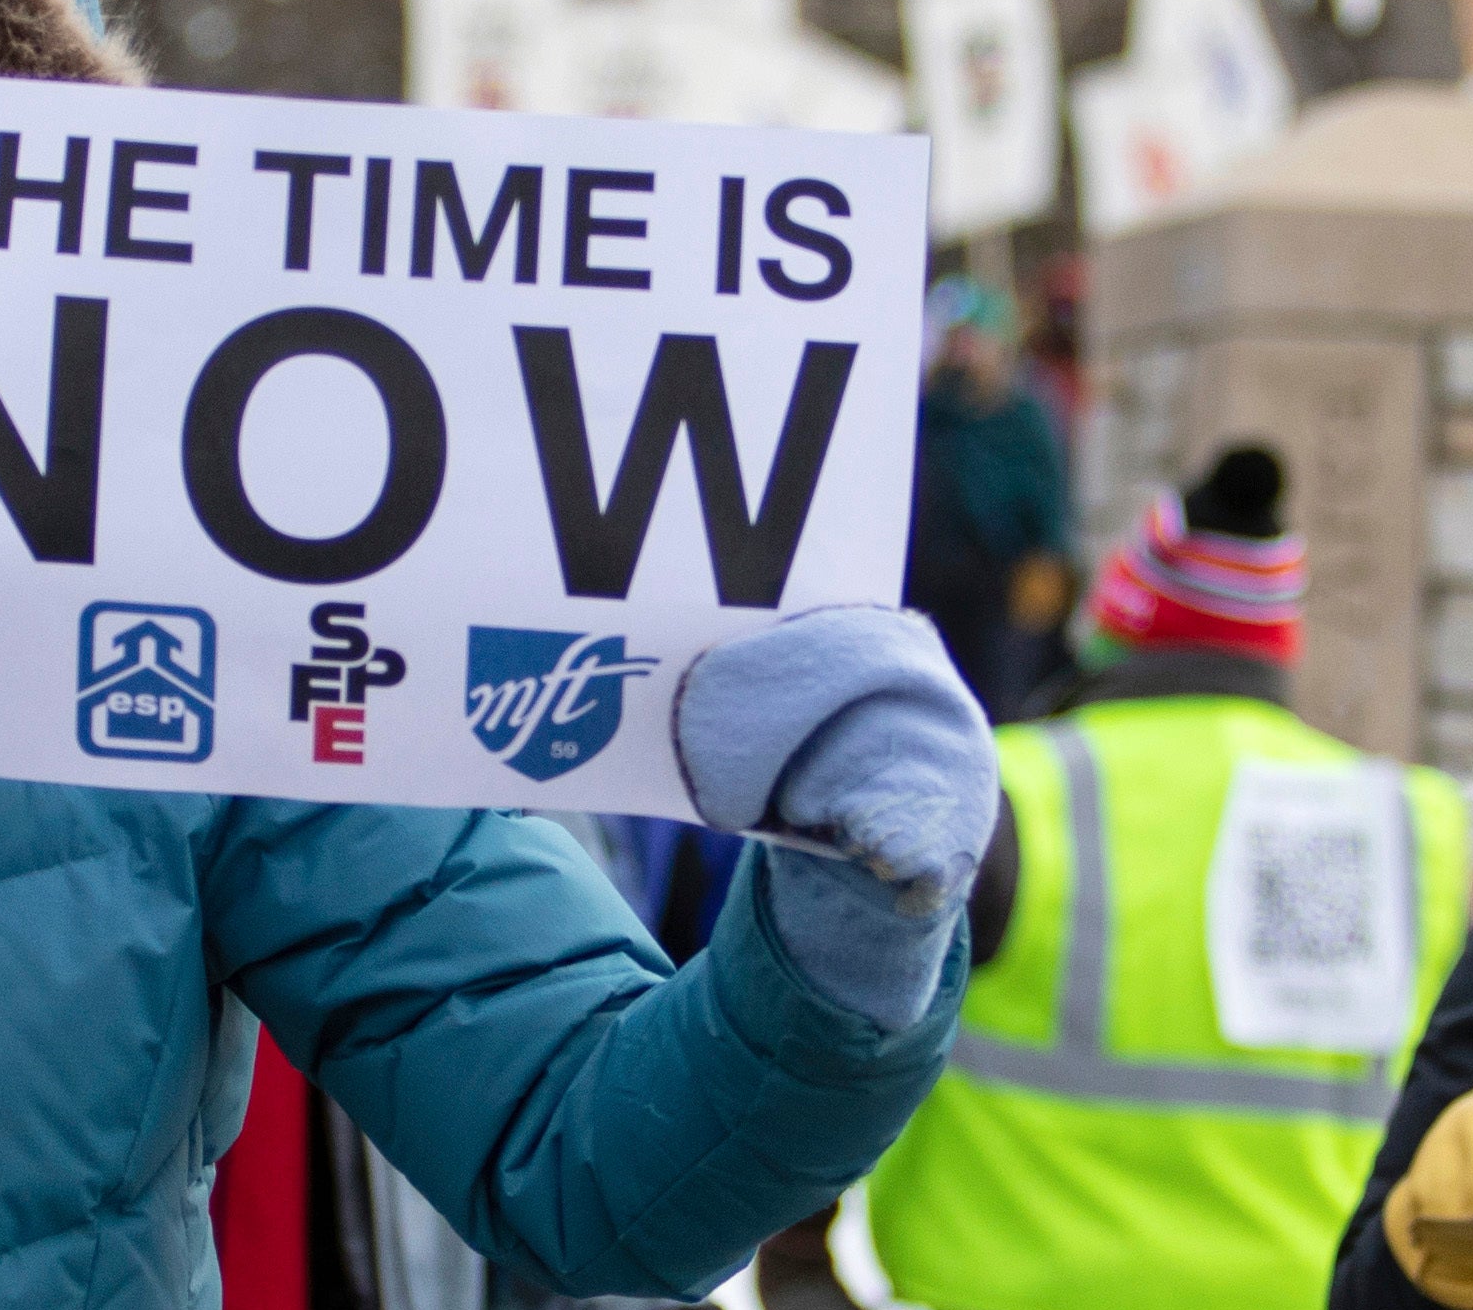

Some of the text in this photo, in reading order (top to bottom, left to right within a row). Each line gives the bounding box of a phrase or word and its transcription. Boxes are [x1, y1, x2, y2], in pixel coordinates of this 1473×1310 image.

[253, 150, 656, 290] TIME
[717, 176, 854, 302] IS
[105, 691, 186, 724] esp
